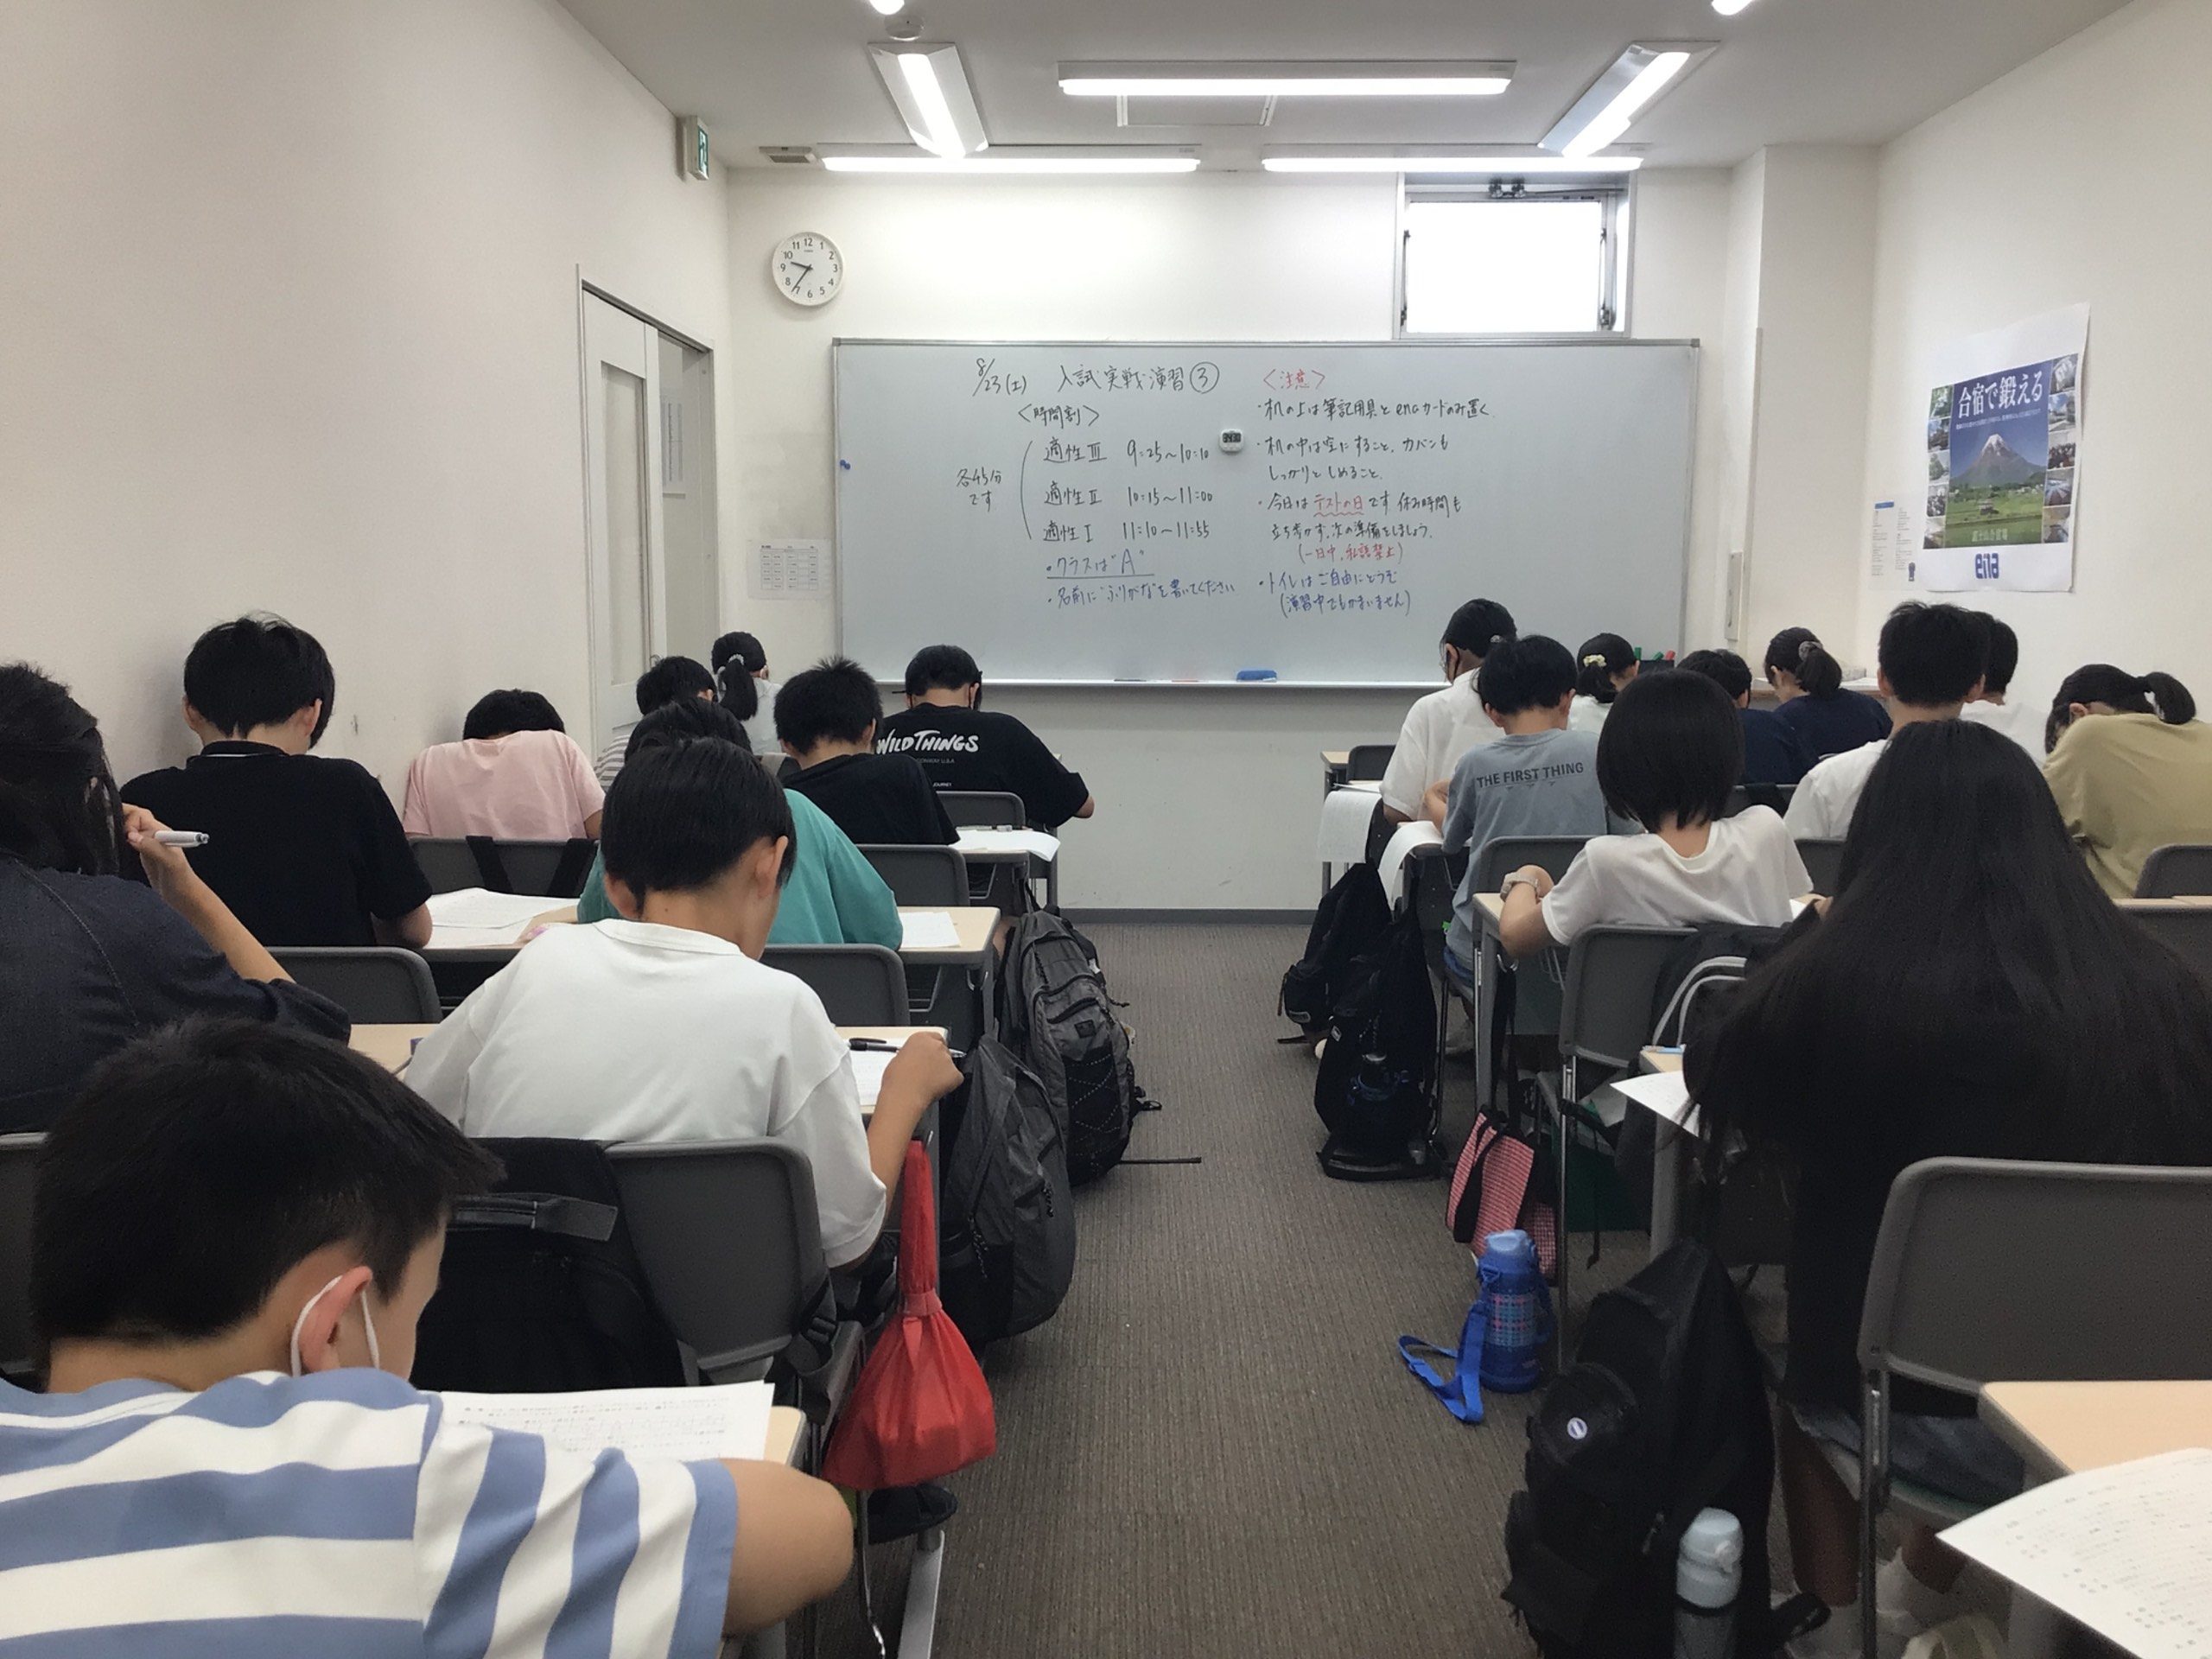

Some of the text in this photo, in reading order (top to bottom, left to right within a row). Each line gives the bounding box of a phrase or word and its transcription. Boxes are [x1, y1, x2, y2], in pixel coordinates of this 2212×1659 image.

[792, 241, 800, 250] 11
[804, 238, 813, 247] 12
[784, 251, 793, 259] 10
[829, 251, 835, 260] 2
[780, 263, 786, 272] 9
[832, 264, 838, 273] 3
[785, 277, 791, 286] 8
[807, 289, 814, 298] 6
[819, 287, 825, 296] 5
[1957, 371, 2044, 419] 合宿で鍛える
[1975, 553, 1999, 579] ena
[1476, 762, 1584, 788] THE FIRST THING
